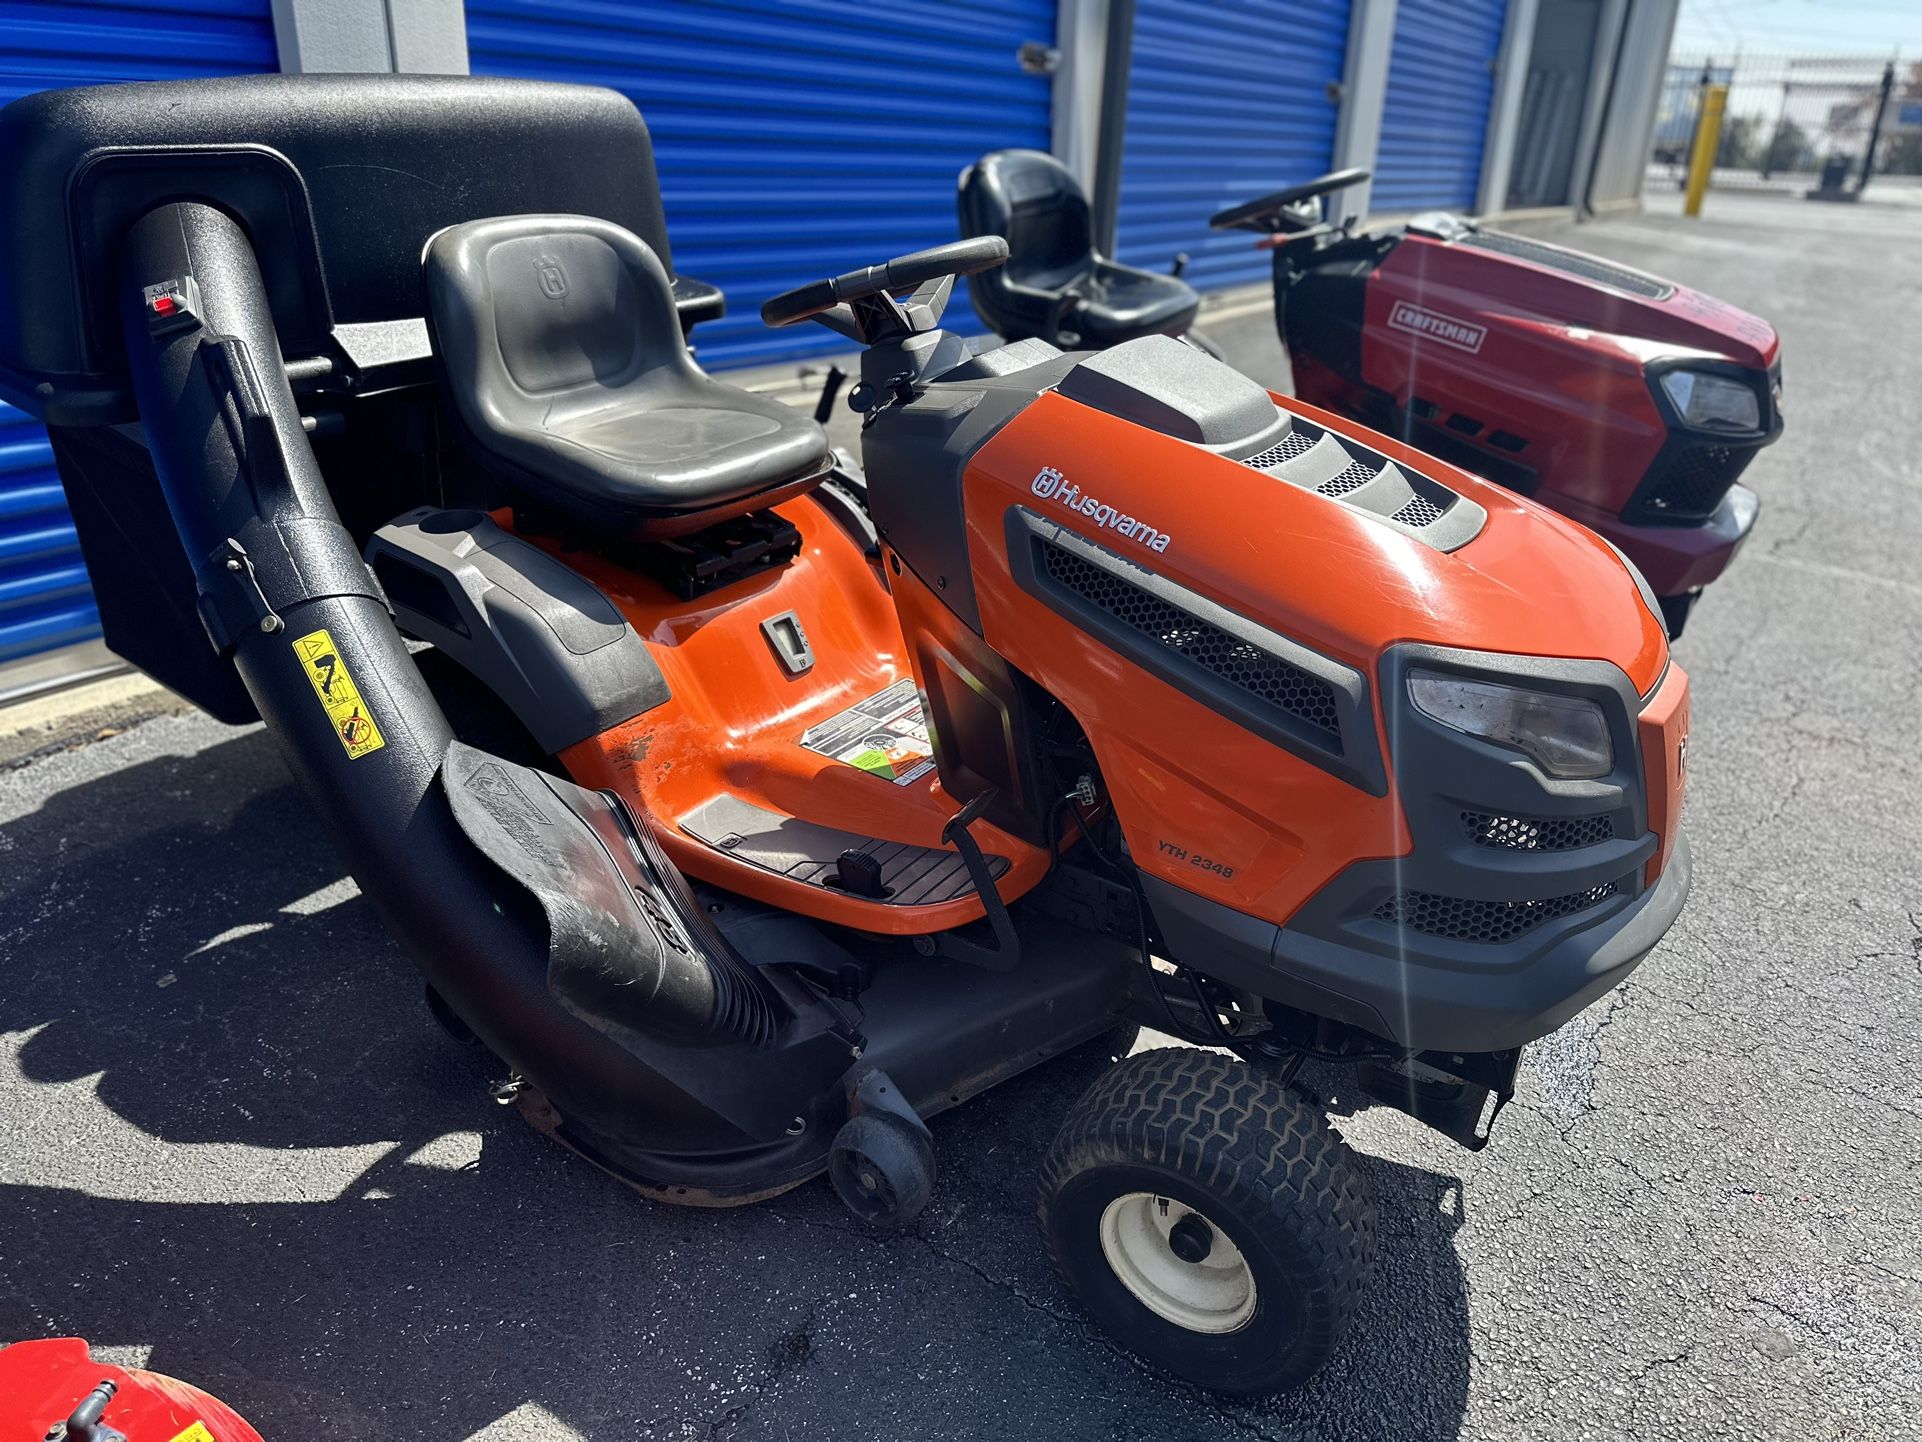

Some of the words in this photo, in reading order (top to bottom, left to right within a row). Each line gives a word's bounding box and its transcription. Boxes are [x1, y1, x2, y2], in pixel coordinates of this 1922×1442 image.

[1396, 309, 1478, 345] CRAFTSMAN
[1053, 480, 1170, 553] Husqvarna
[1159, 840, 1187, 860] YTH
[1191, 855, 1234, 878] 2348
